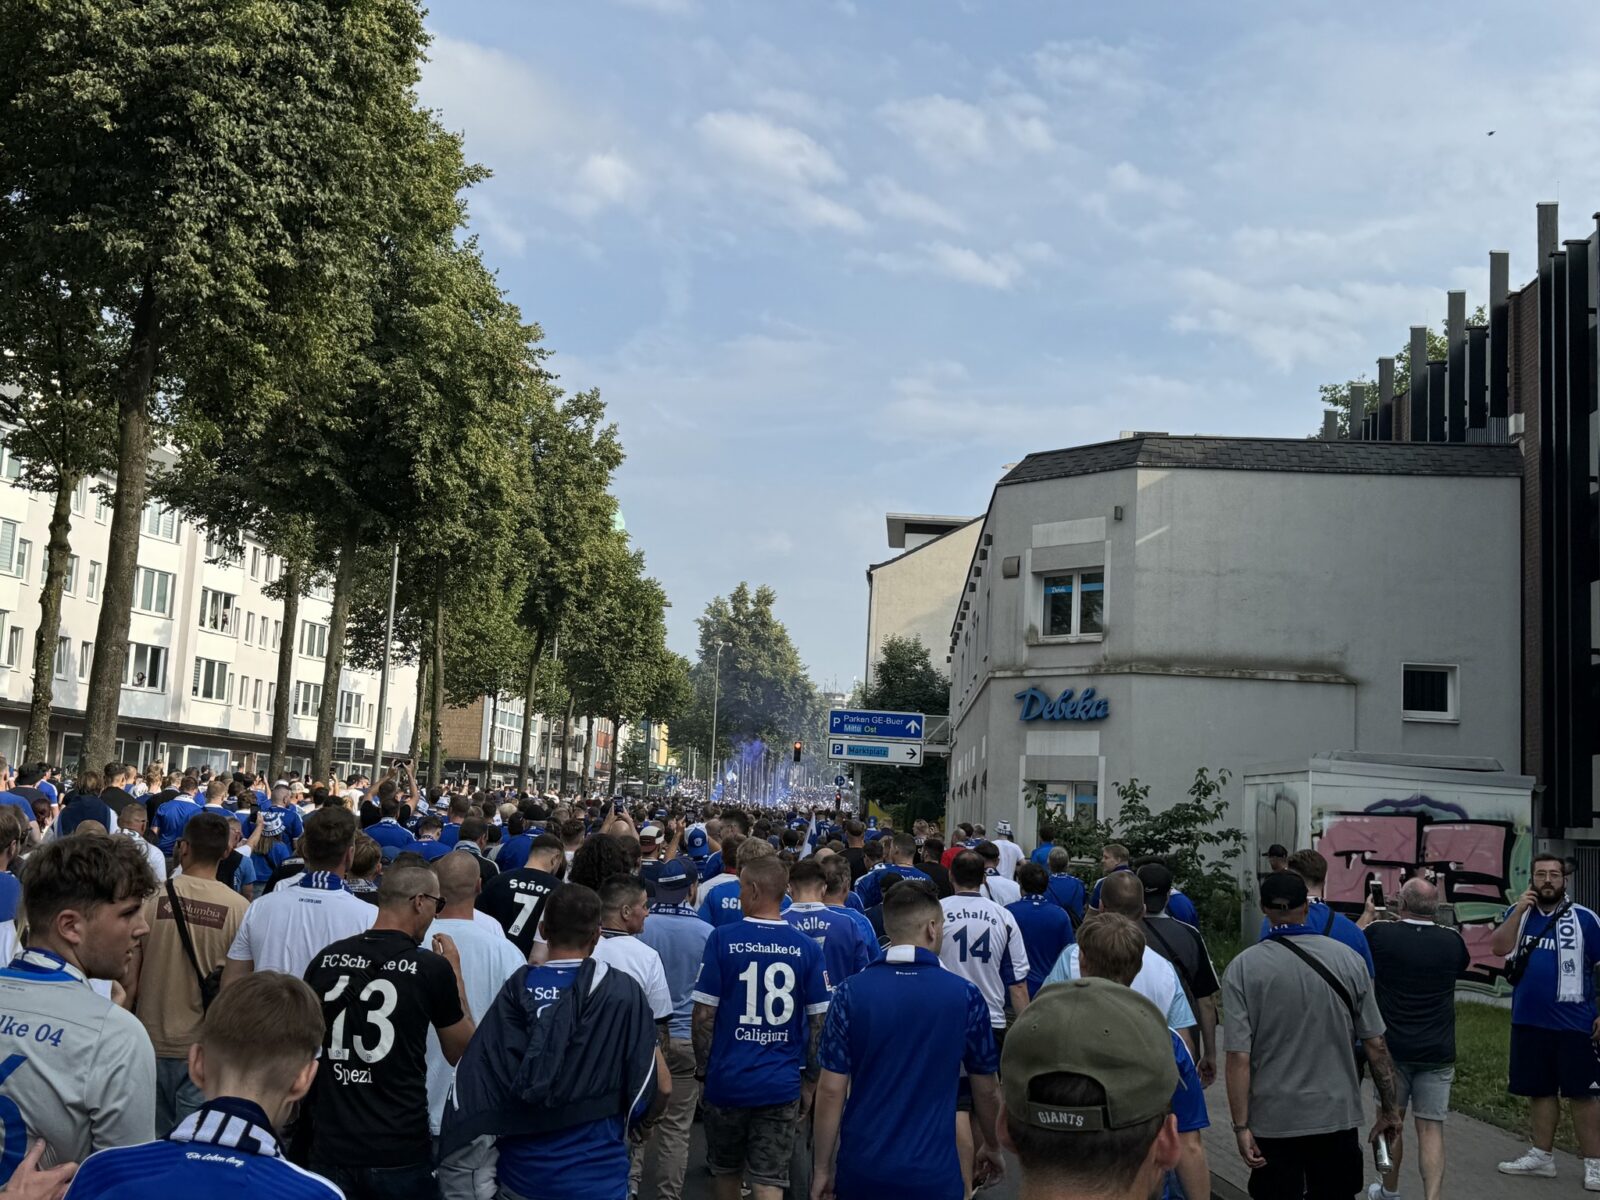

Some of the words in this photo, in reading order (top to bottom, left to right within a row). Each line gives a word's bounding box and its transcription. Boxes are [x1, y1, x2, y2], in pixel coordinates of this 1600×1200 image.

[1014, 687, 1109, 721] Debeka
[843, 714, 870, 724] Parken
[871, 716, 904, 725] GE-Buer
[864, 725, 877, 733] Ost
[847, 745, 888, 757] Marktplatz
[509, 879, 551, 894] Señor
[508, 892, 540, 937] 7
[946, 908, 998, 926] Schalke
[728, 943, 744, 954] FC
[745, 942, 788, 954] Schalke
[789, 945, 802, 957] 04
[952, 924, 992, 964] 14
[320, 954, 339, 968] FC
[398, 959, 418, 975] 04
[738, 960, 796, 1026] 18
[323, 974, 398, 1064] 13
[35, 1023, 65, 1048] 04
[734, 1027, 789, 1045] Caligiuri
[333, 1062, 374, 1086] Spezi
[1037, 1111, 1085, 1127] GIANTS
